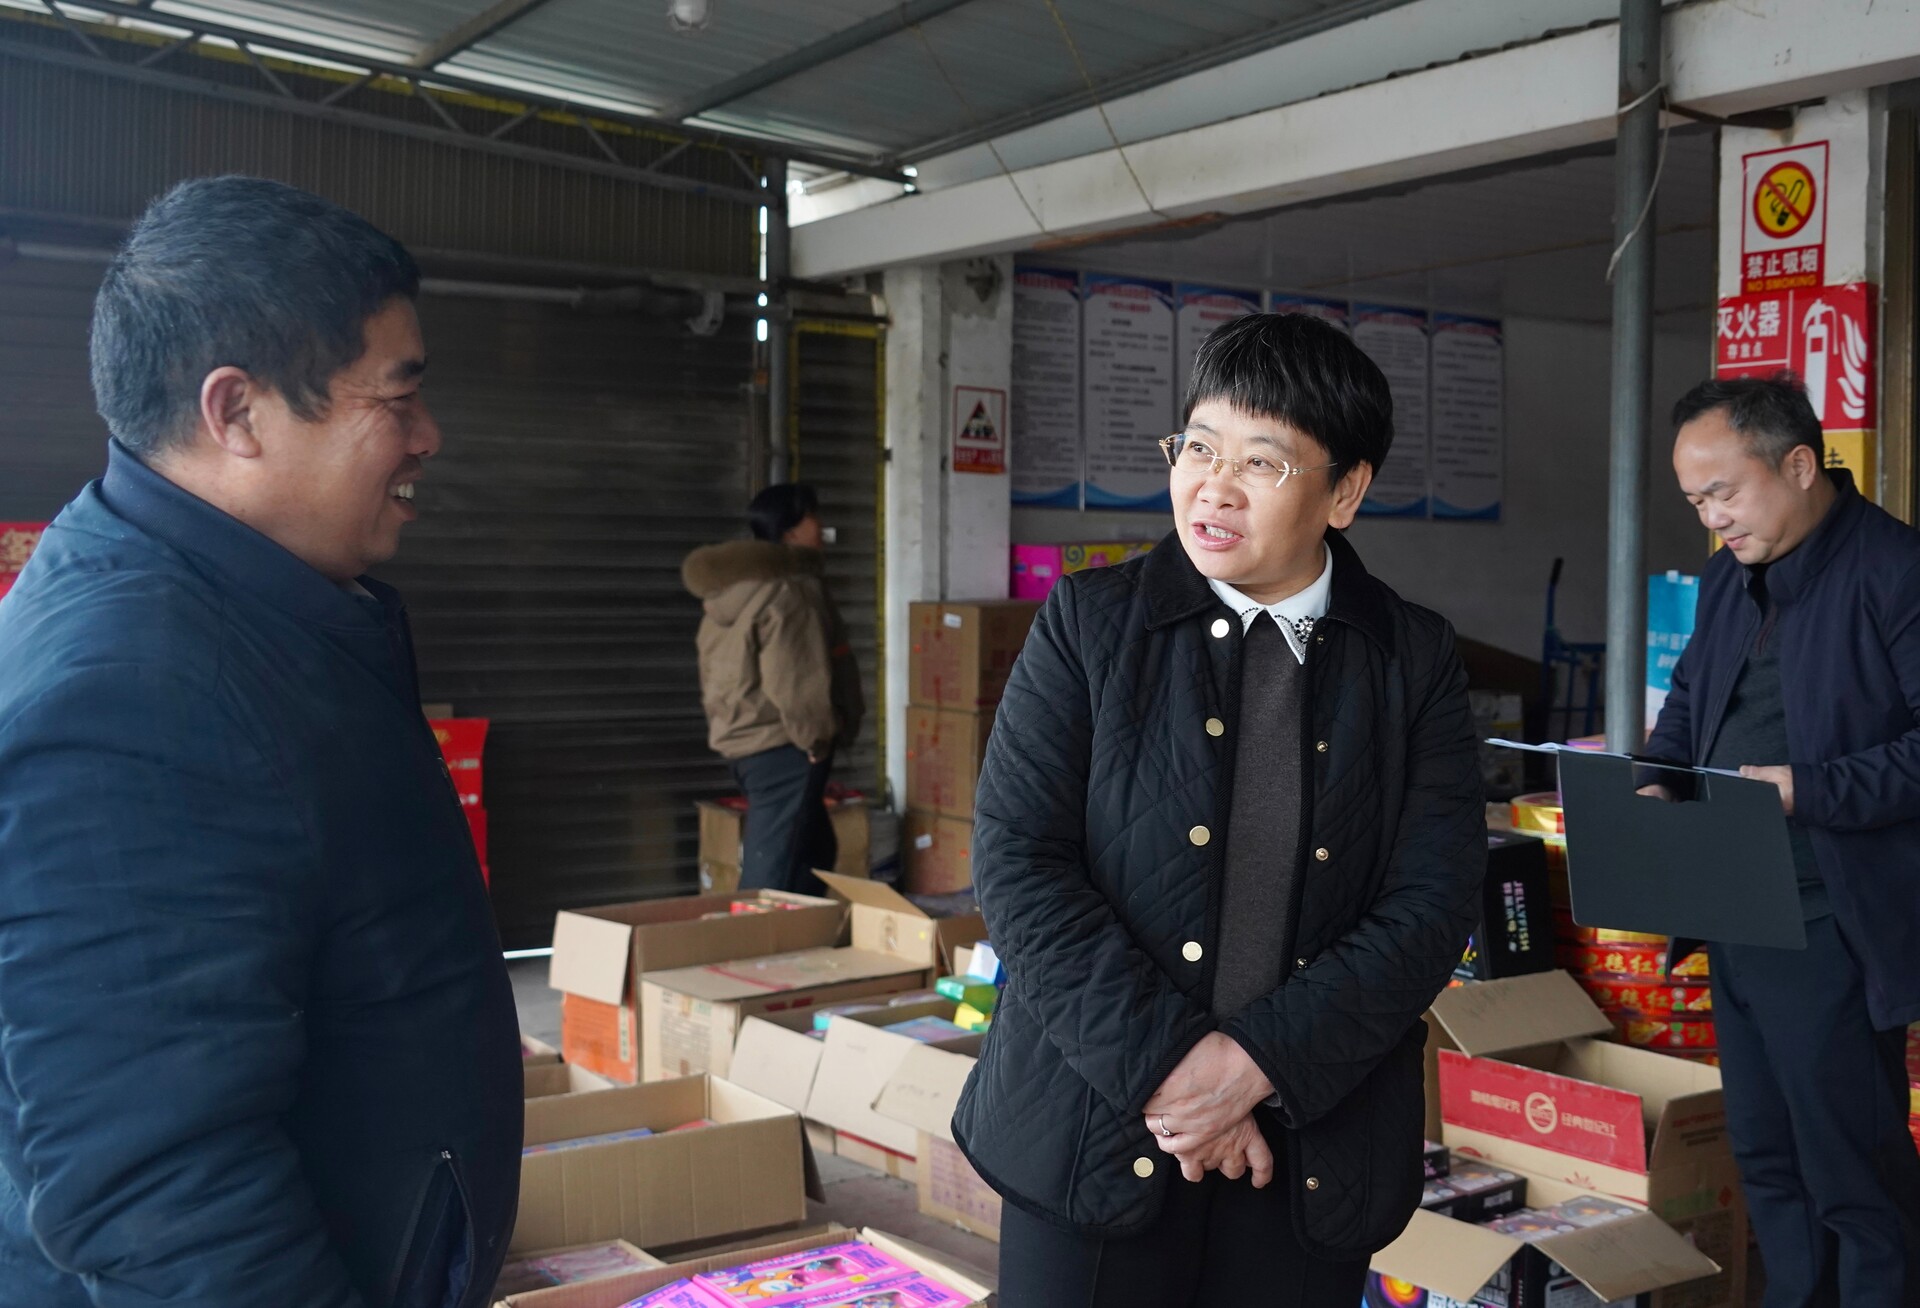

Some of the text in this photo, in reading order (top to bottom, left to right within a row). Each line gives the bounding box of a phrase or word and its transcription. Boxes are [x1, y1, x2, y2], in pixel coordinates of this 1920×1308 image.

[1747, 248, 1818, 279] 禁止吸烟
[1747, 274, 1817, 292] NO SMOKING
[1717, 300, 1780, 339] 灭火器
[1513, 880, 1530, 951] JELLYFISH
